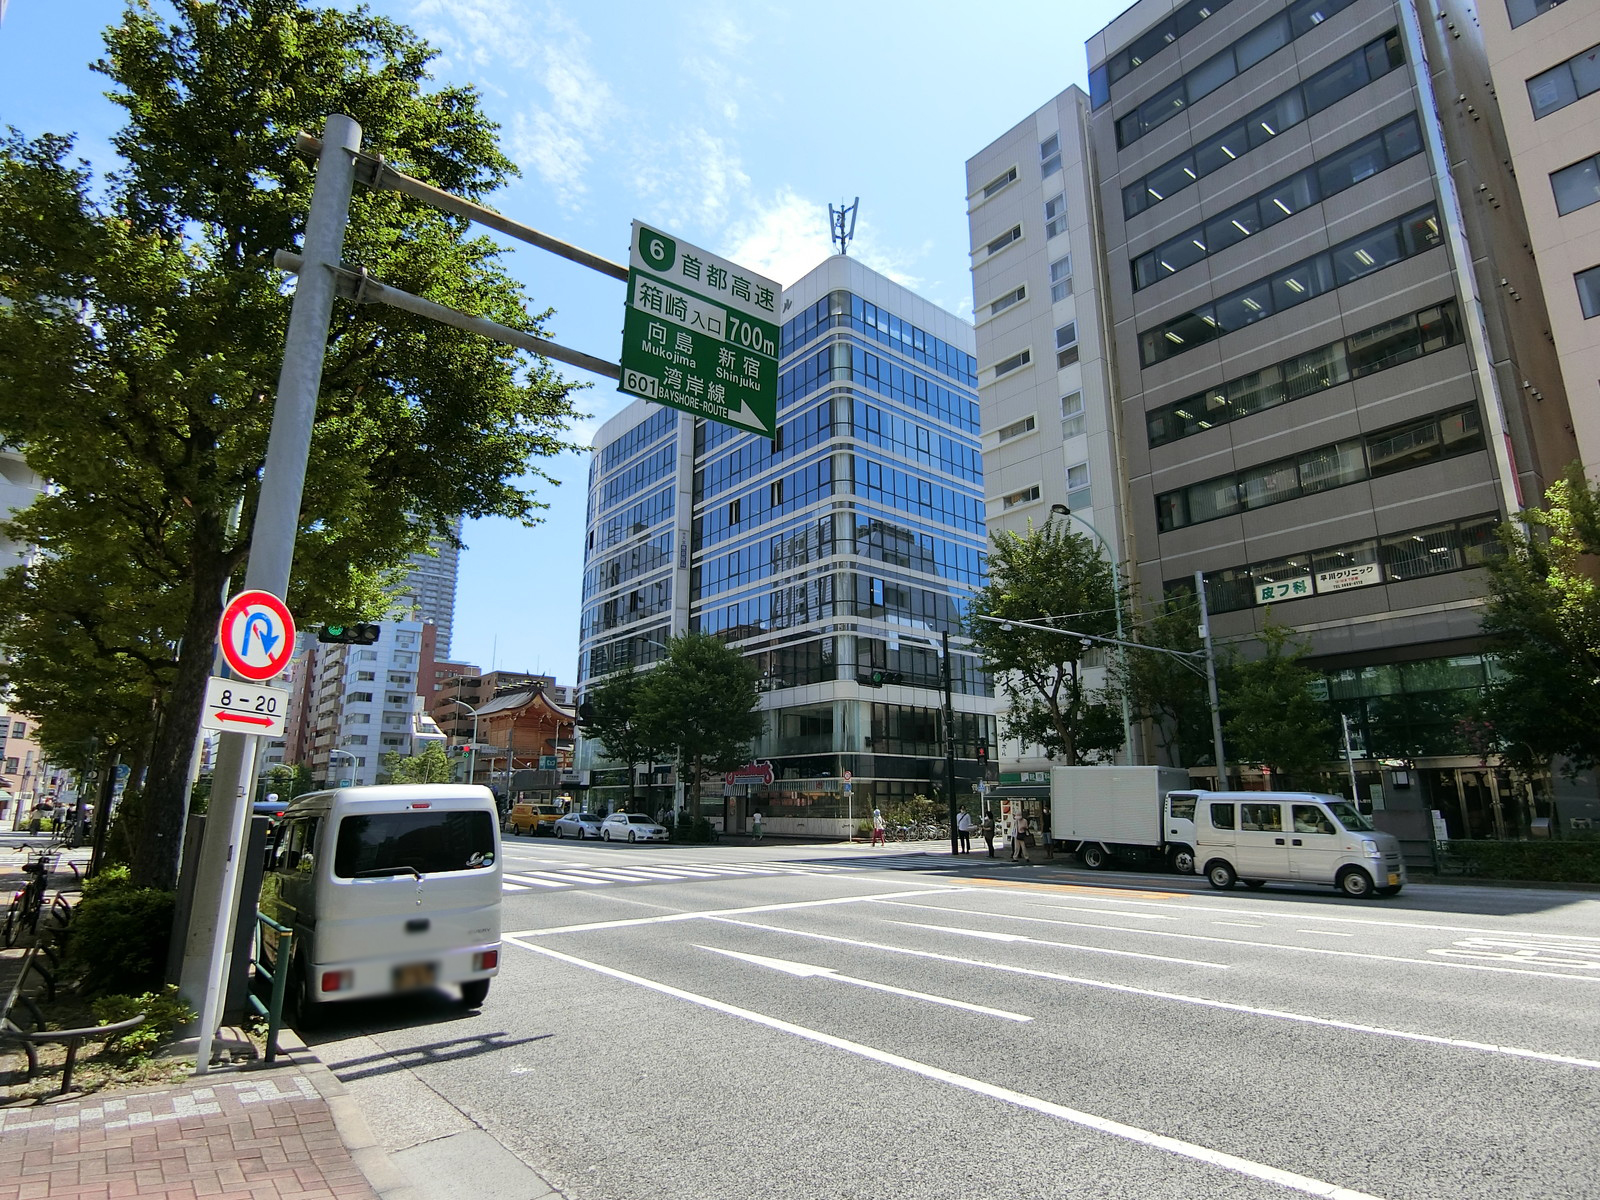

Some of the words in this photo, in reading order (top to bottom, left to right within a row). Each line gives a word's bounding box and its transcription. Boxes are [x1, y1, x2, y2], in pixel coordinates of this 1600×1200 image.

[649, 239, 665, 261] 6
[681, 253, 775, 313] 首都高速
[648, 321, 694, 355] 向島
[729, 315, 775, 357] 700m
[641, 340, 697, 369] Mukojima
[718, 347, 761, 379] 新宿
[627, 372, 658, 399] 601
[663, 365, 726, 404] 湾岸線
[715, 366, 761, 392] Shinjuku
[658, 386, 728, 419] BAYSHORE-ROUTE
[1320, 566, 1374, 582] 早川クリニック
[1261, 579, 1307, 601] 皮フ科
